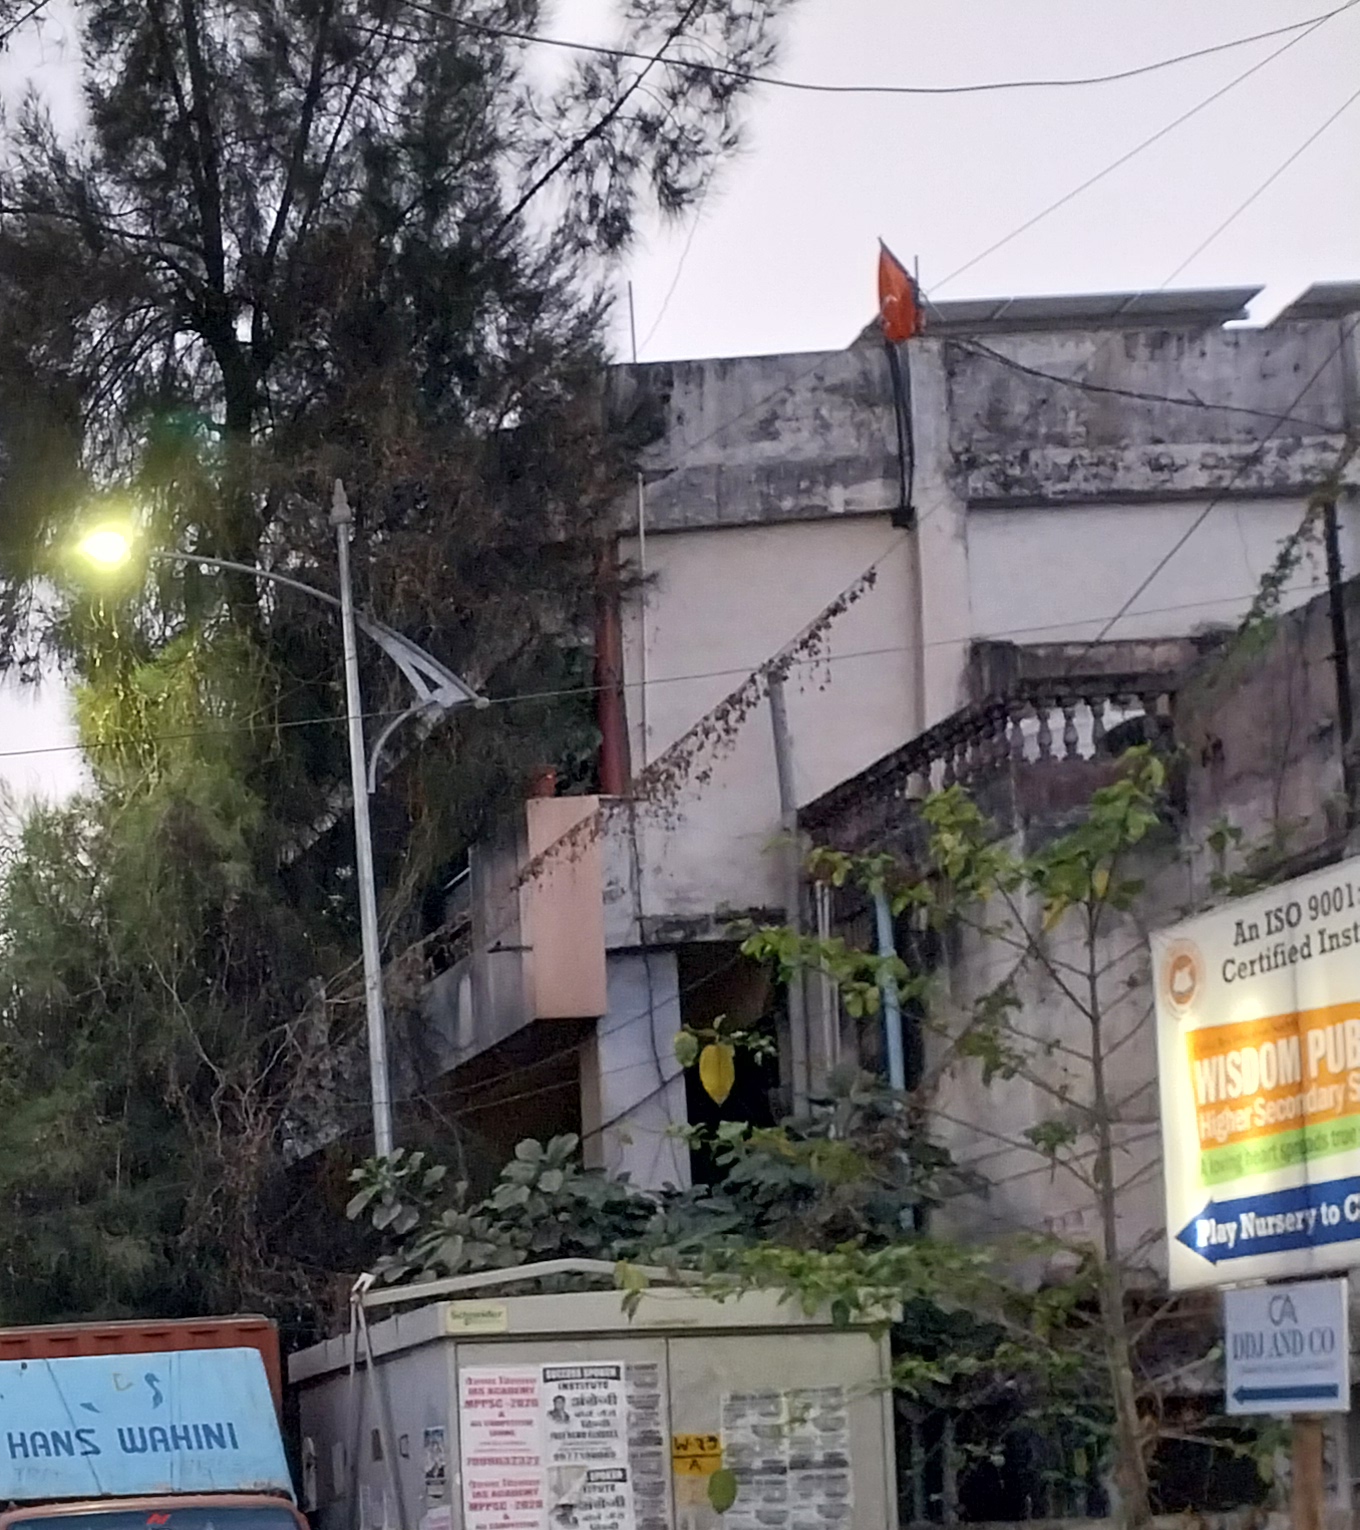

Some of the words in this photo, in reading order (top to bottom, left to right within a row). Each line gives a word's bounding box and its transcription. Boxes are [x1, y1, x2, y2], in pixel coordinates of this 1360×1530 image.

[1233, 919, 1259, 946] An
[1264, 902, 1301, 936] ISO
[1222, 934, 1312, 983] Certified
[1194, 1036, 1301, 1105] WISDOM
[1307, 1019, 1360, 1078] PUB
[1199, 1106, 1253, 1143] Higher
[1254, 1081, 1346, 1127] Secondary
[1195, 1217, 1238, 1249] Play
[1239, 1206, 1317, 1240] Nursery
[1320, 1201, 1341, 1227] to
[1269, 1294, 1298, 1327] CA
[1267, 1329, 1304, 1358] AND
[1309, 1326, 1335, 1354] CO
[7, 1428, 101, 1459] HANS
[117, 1422, 240, 1454] WAHINI
